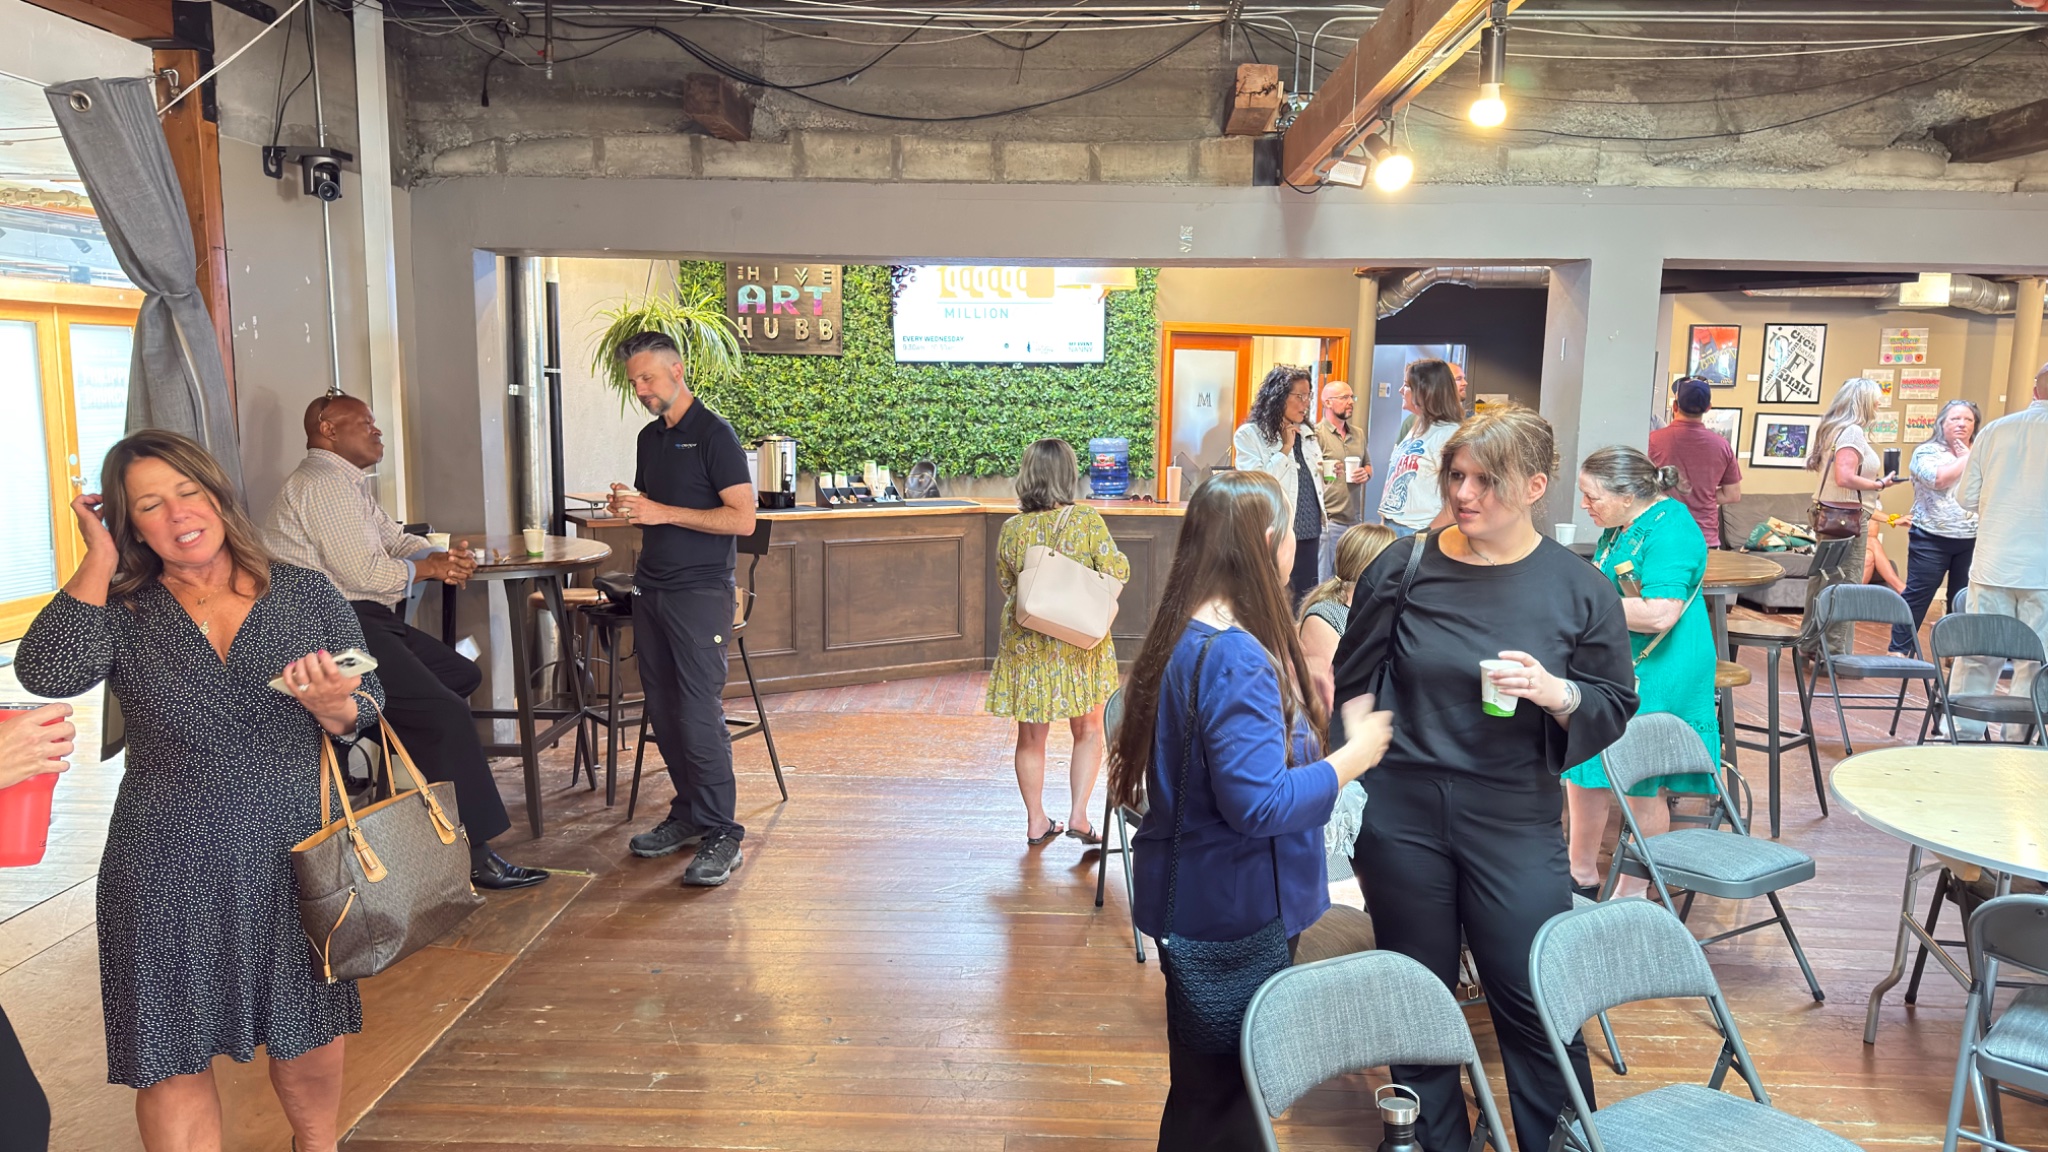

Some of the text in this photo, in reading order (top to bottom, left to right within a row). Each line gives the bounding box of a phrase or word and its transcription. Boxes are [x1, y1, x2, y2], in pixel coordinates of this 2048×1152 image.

[747, 265, 832, 287] HIVE
[737, 284, 832, 316] ART
[944, 307, 1009, 319] MILLION
[738, 316, 834, 341] HUBB
